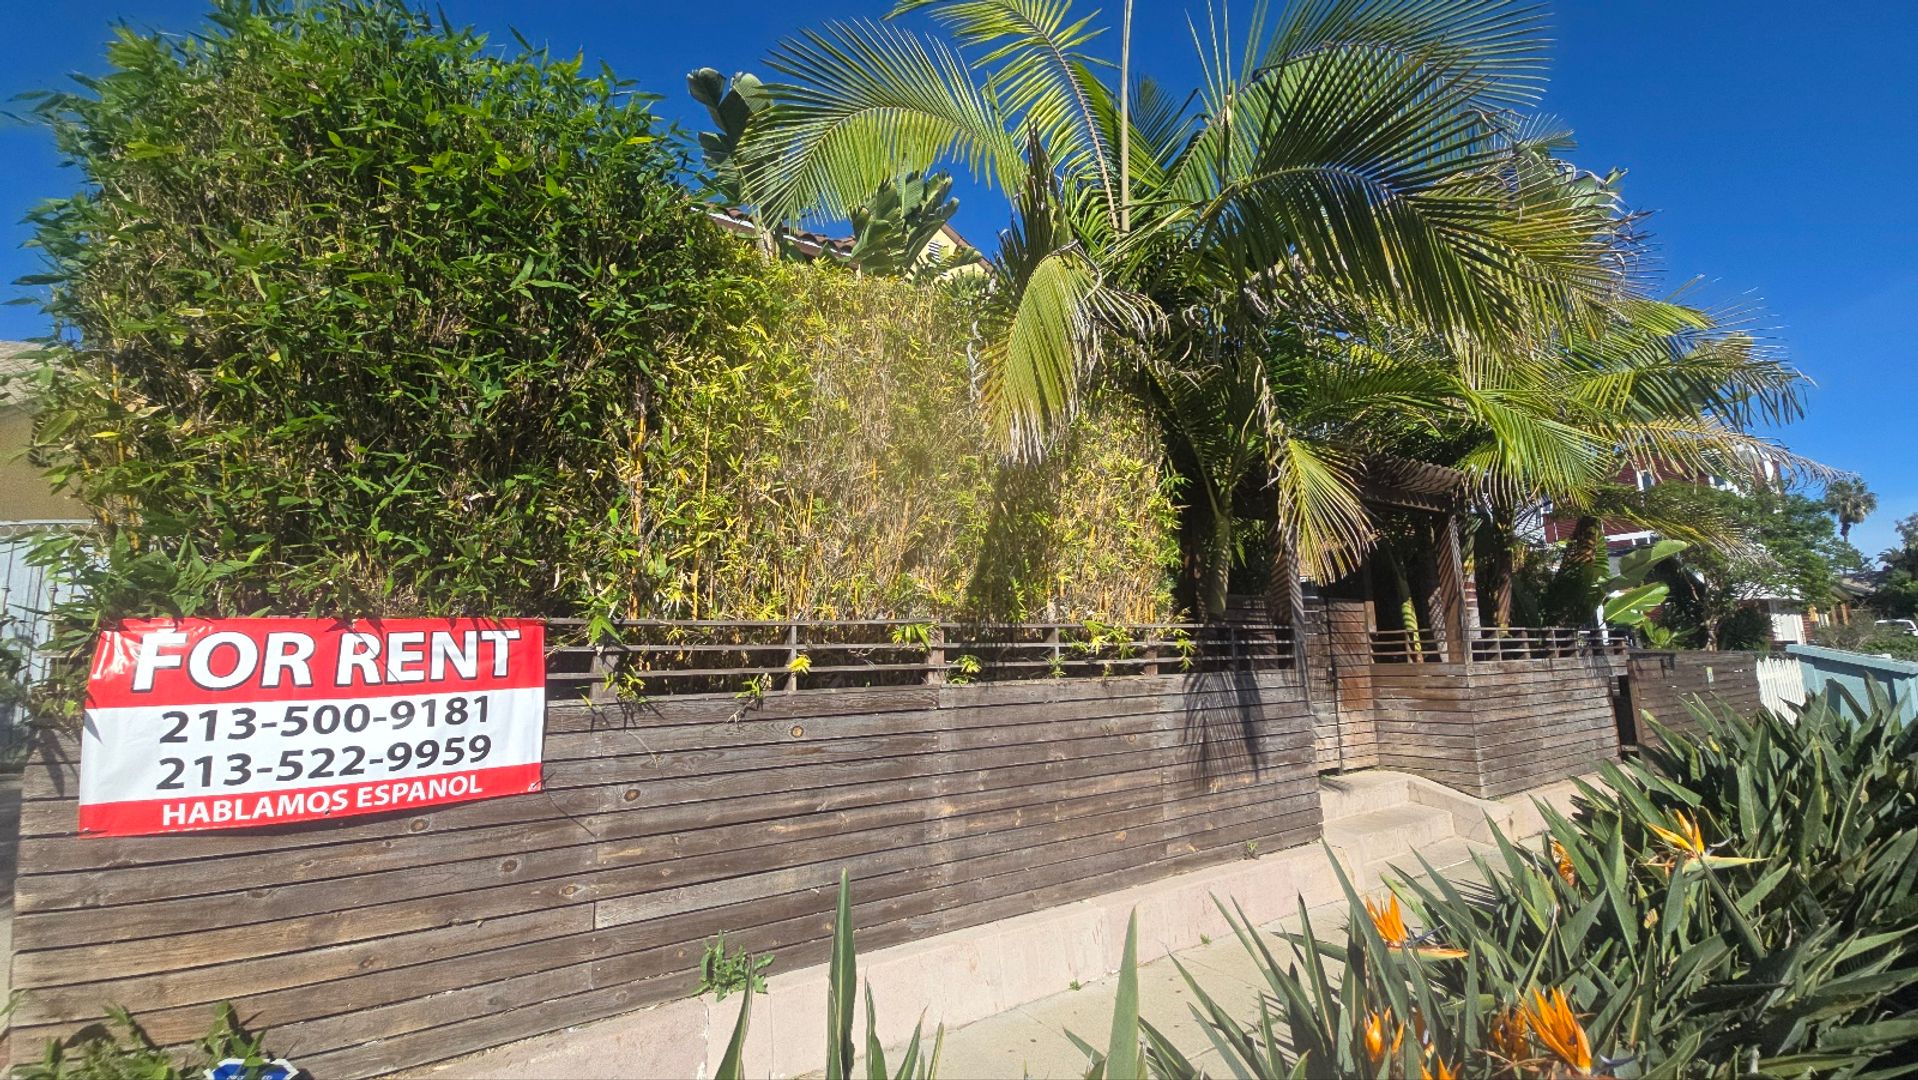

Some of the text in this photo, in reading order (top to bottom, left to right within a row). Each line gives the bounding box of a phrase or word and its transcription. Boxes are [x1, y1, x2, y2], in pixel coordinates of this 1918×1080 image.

[131, 629, 522, 693] FOR RENT
[158, 695, 490, 744] 213-500-9181
[156, 734, 492, 790] 213-522-9959
[161, 774, 483, 826] HABLAMOS ESPANOL
